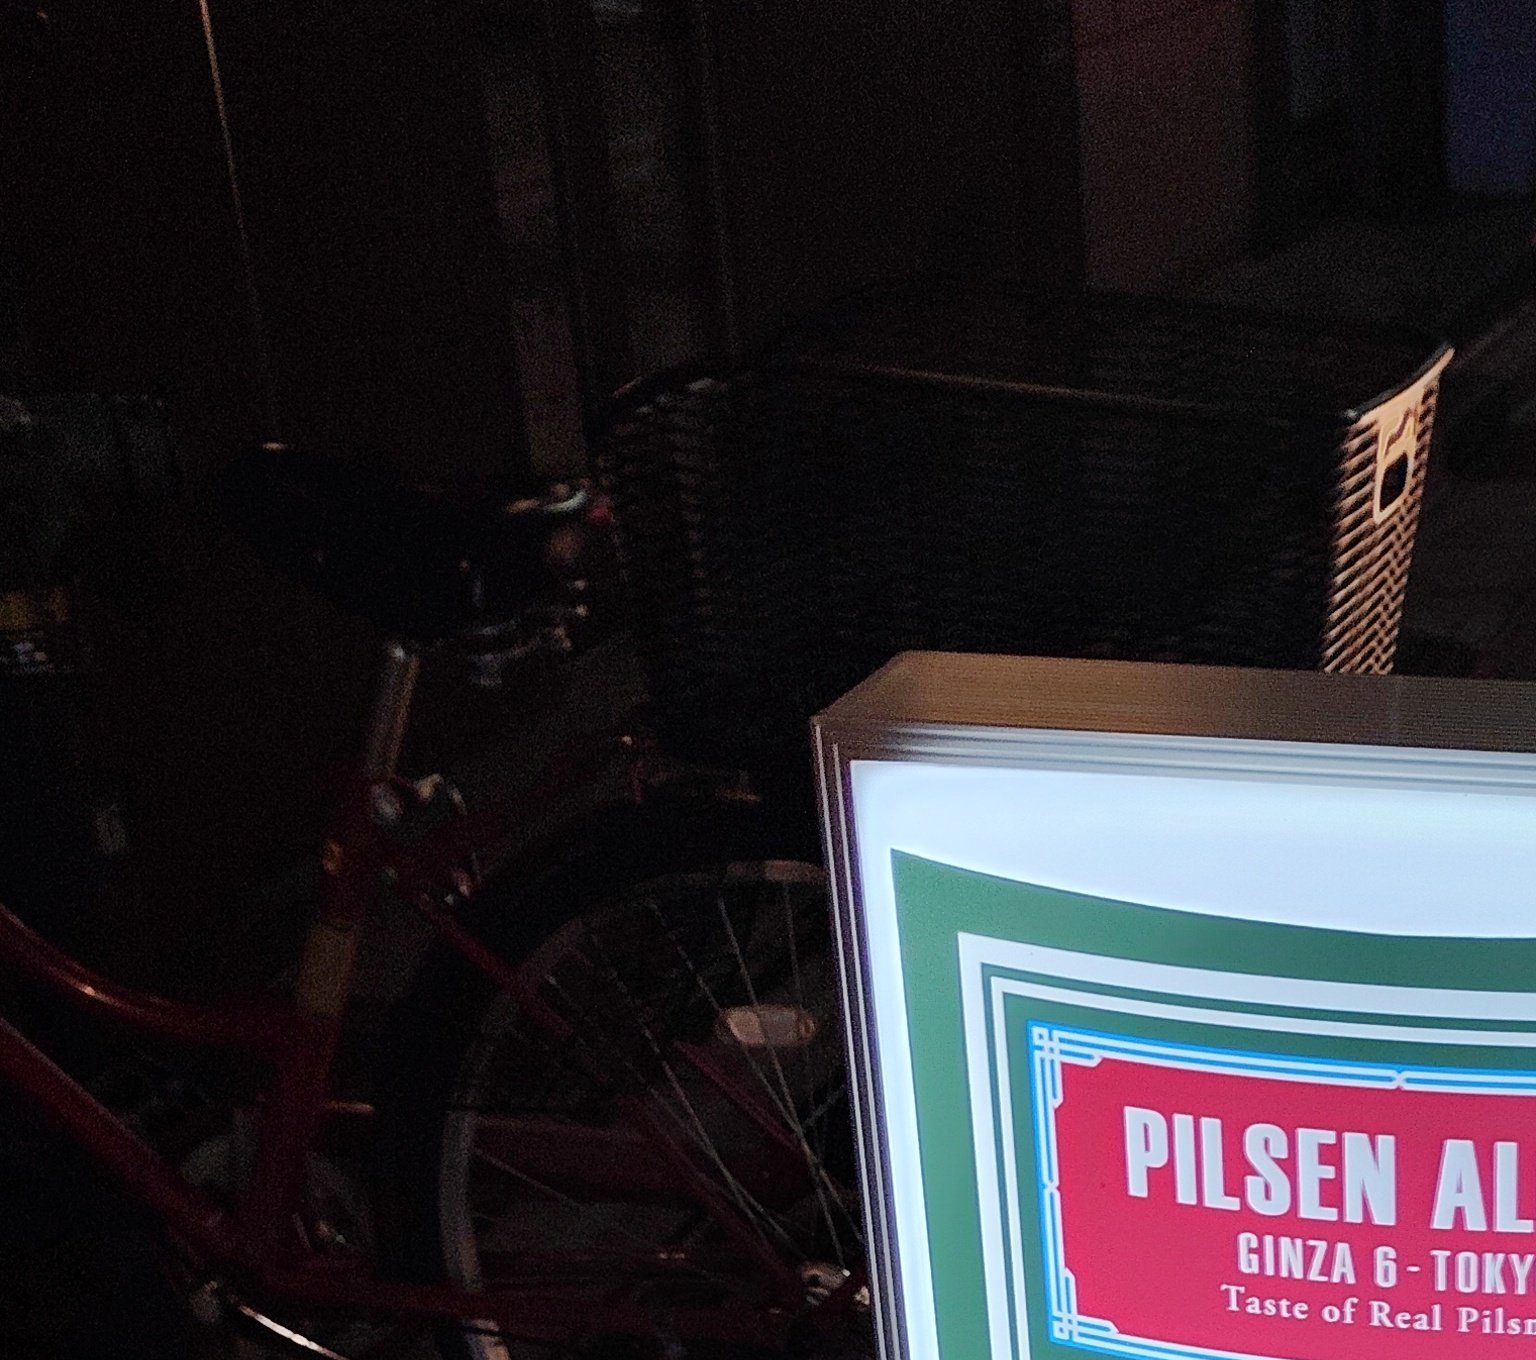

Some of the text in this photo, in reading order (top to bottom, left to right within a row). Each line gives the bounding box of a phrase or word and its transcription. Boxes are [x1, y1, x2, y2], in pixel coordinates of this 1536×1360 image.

[1122, 1105, 1397, 1227] PILSEN
[1237, 1232, 1356, 1285] GINZA
[1373, 1247, 1397, 1288] 6
[1220, 1284, 1310, 1322] Taste
[1321, 1297, 1358, 1326] of
[1369, 1302, 1443, 1333] Real
